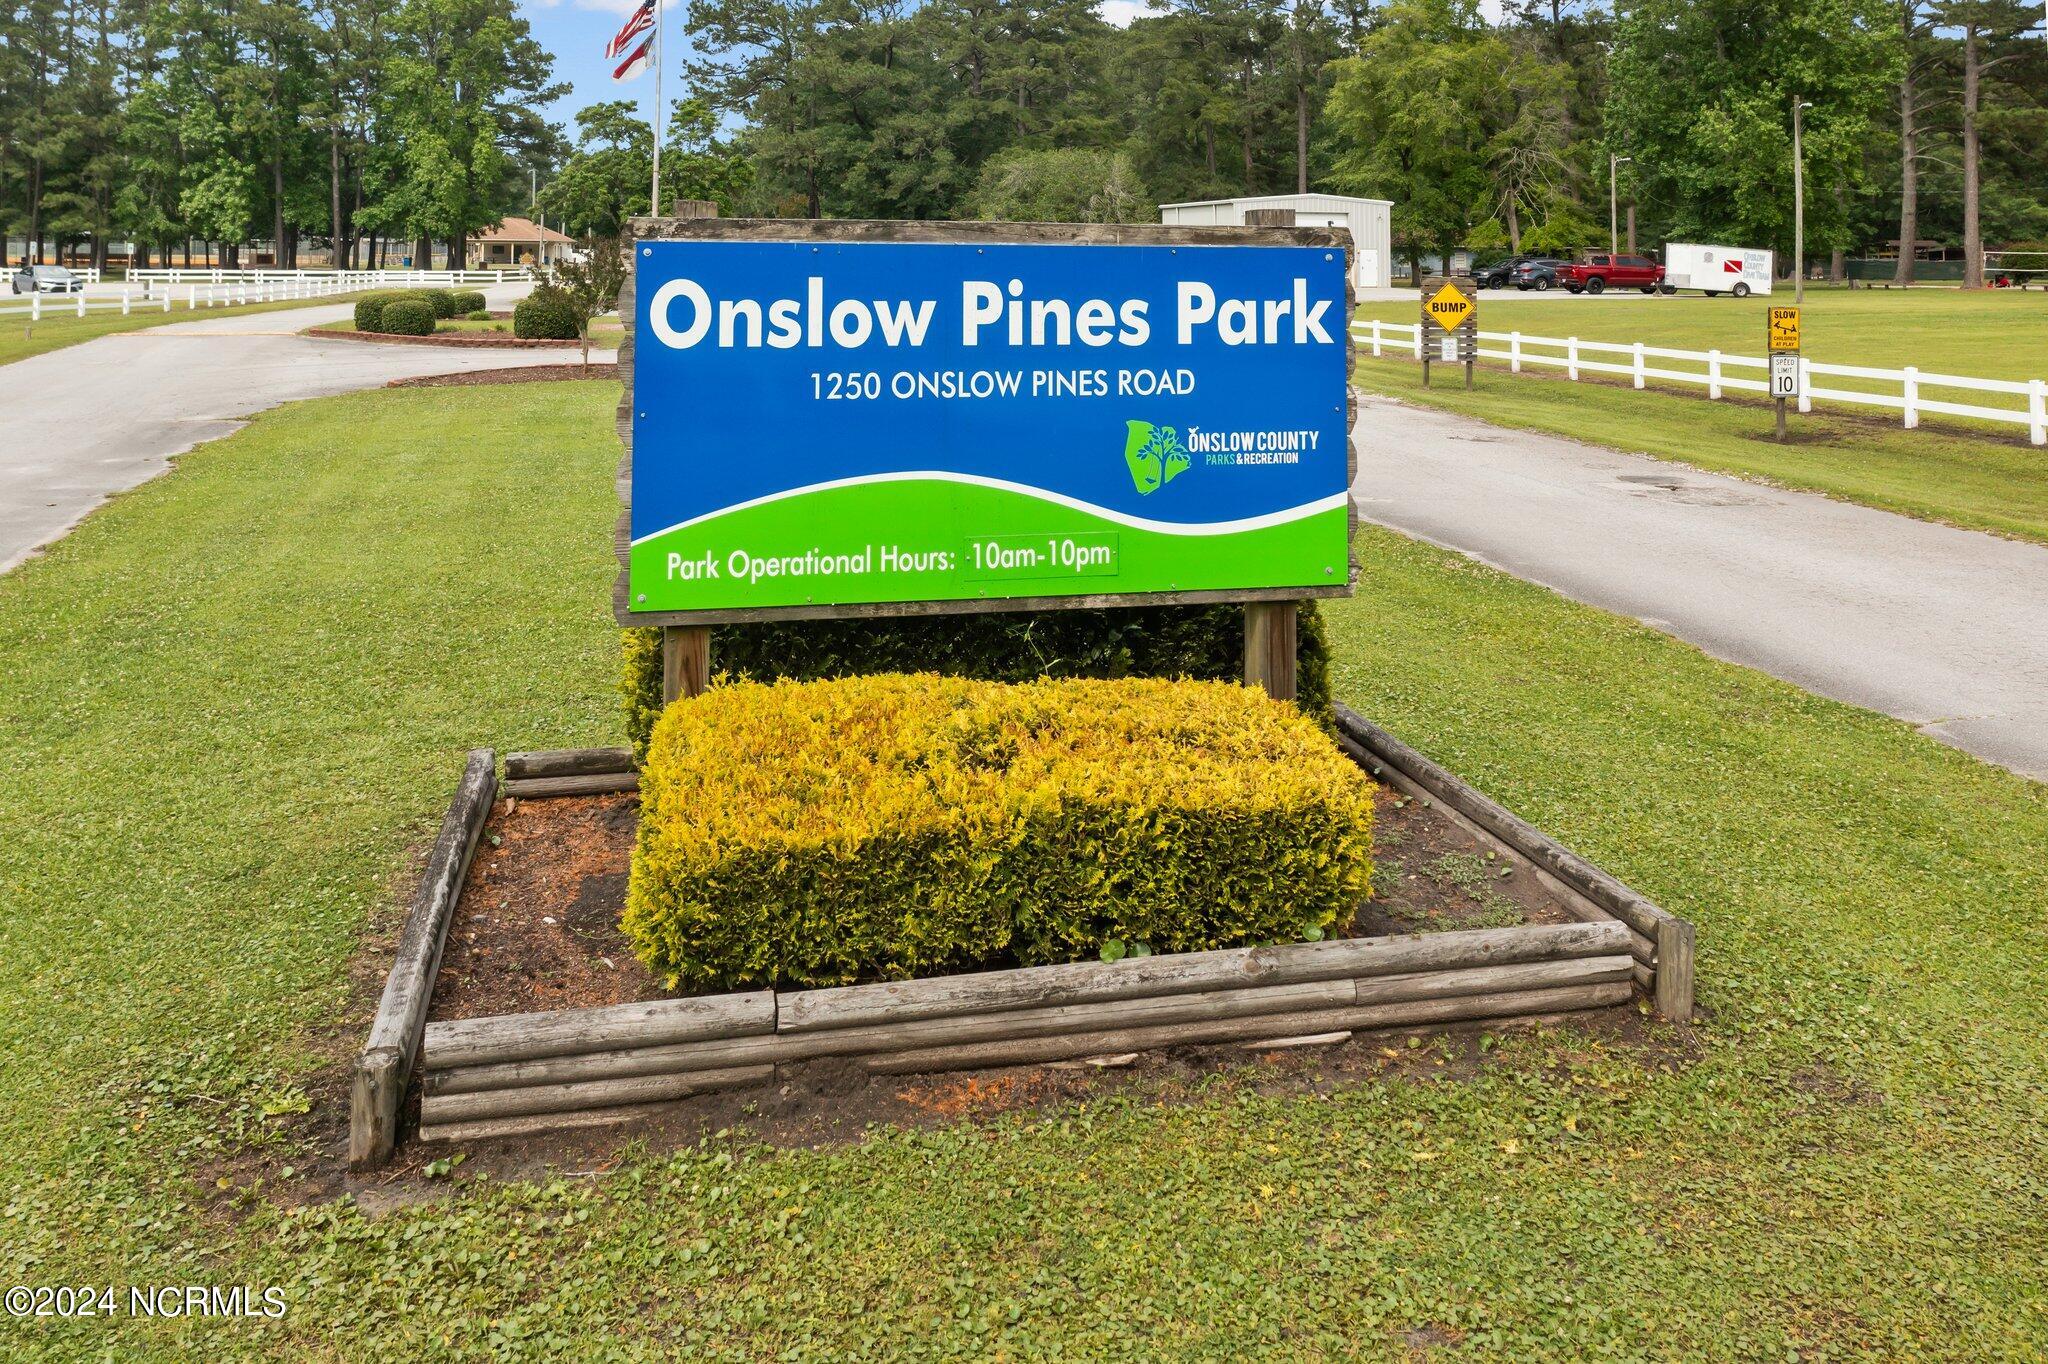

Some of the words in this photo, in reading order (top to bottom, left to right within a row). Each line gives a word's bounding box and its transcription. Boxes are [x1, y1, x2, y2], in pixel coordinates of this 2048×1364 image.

[649, 276, 937, 350] Onslow
[962, 278, 1151, 347] Pines
[1177, 278, 1335, 346] Park
[1432, 302, 1467, 313] BUMP
[1774, 310, 1796, 319] SLOW
[811, 372, 881, 401] 1250
[891, 370, 1023, 400] ONSLOW
[1032, 369, 1108, 397] PINES
[1118, 368, 1195, 396] ROAD
[1778, 376, 1793, 392] 10
[1188, 430, 1255, 453] ONSLOW
[1257, 430, 1319, 451] COUNTY
[1205, 454, 1235, 466] PARKS
[667, 549, 720, 580] Park
[727, 544, 872, 585] Operational
[880, 545, 956, 573] Hours:
[971, 538, 1111, 573] 10am-10pm
